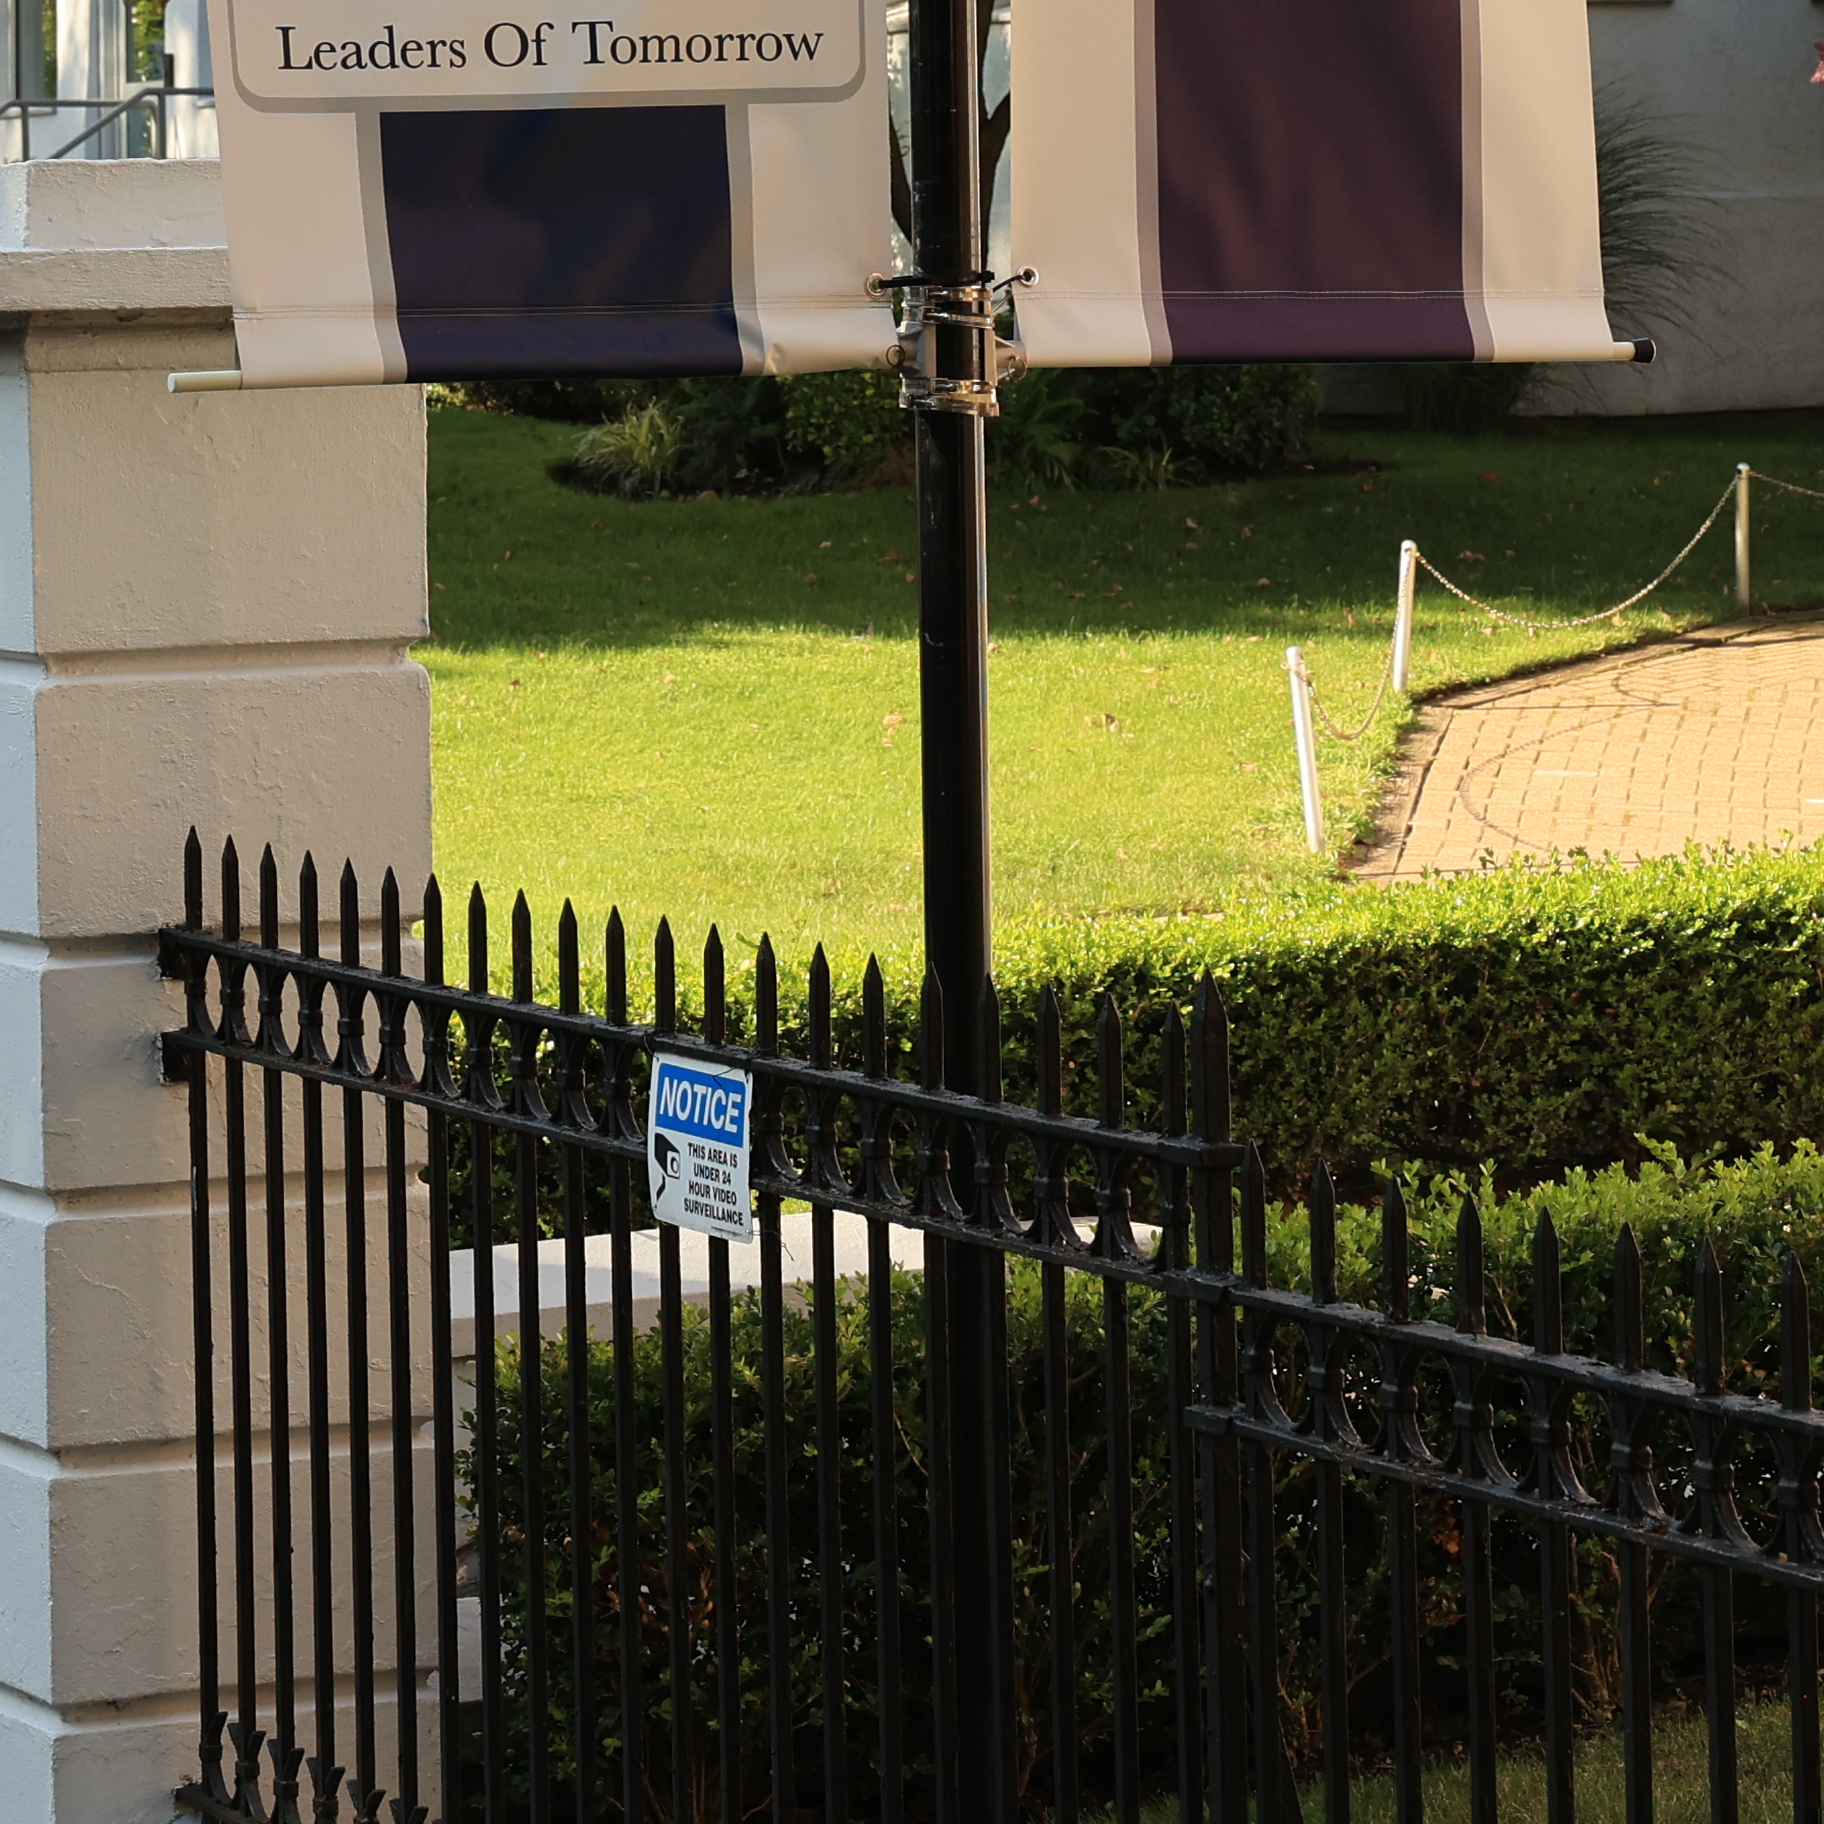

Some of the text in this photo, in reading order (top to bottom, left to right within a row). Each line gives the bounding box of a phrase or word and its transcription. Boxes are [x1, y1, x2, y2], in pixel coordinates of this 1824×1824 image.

[276, 20, 823, 70] Leaders Of Tomorrow
[659, 1077, 741, 1133] NOTICE
[688, 1143, 738, 1168] THIS AREA IS
[694, 1163, 731, 1186] UNDER 24
[689, 1180, 737, 1205] HOUR VIDEO
[684, 1198, 744, 1226] SURVEILLANCE
